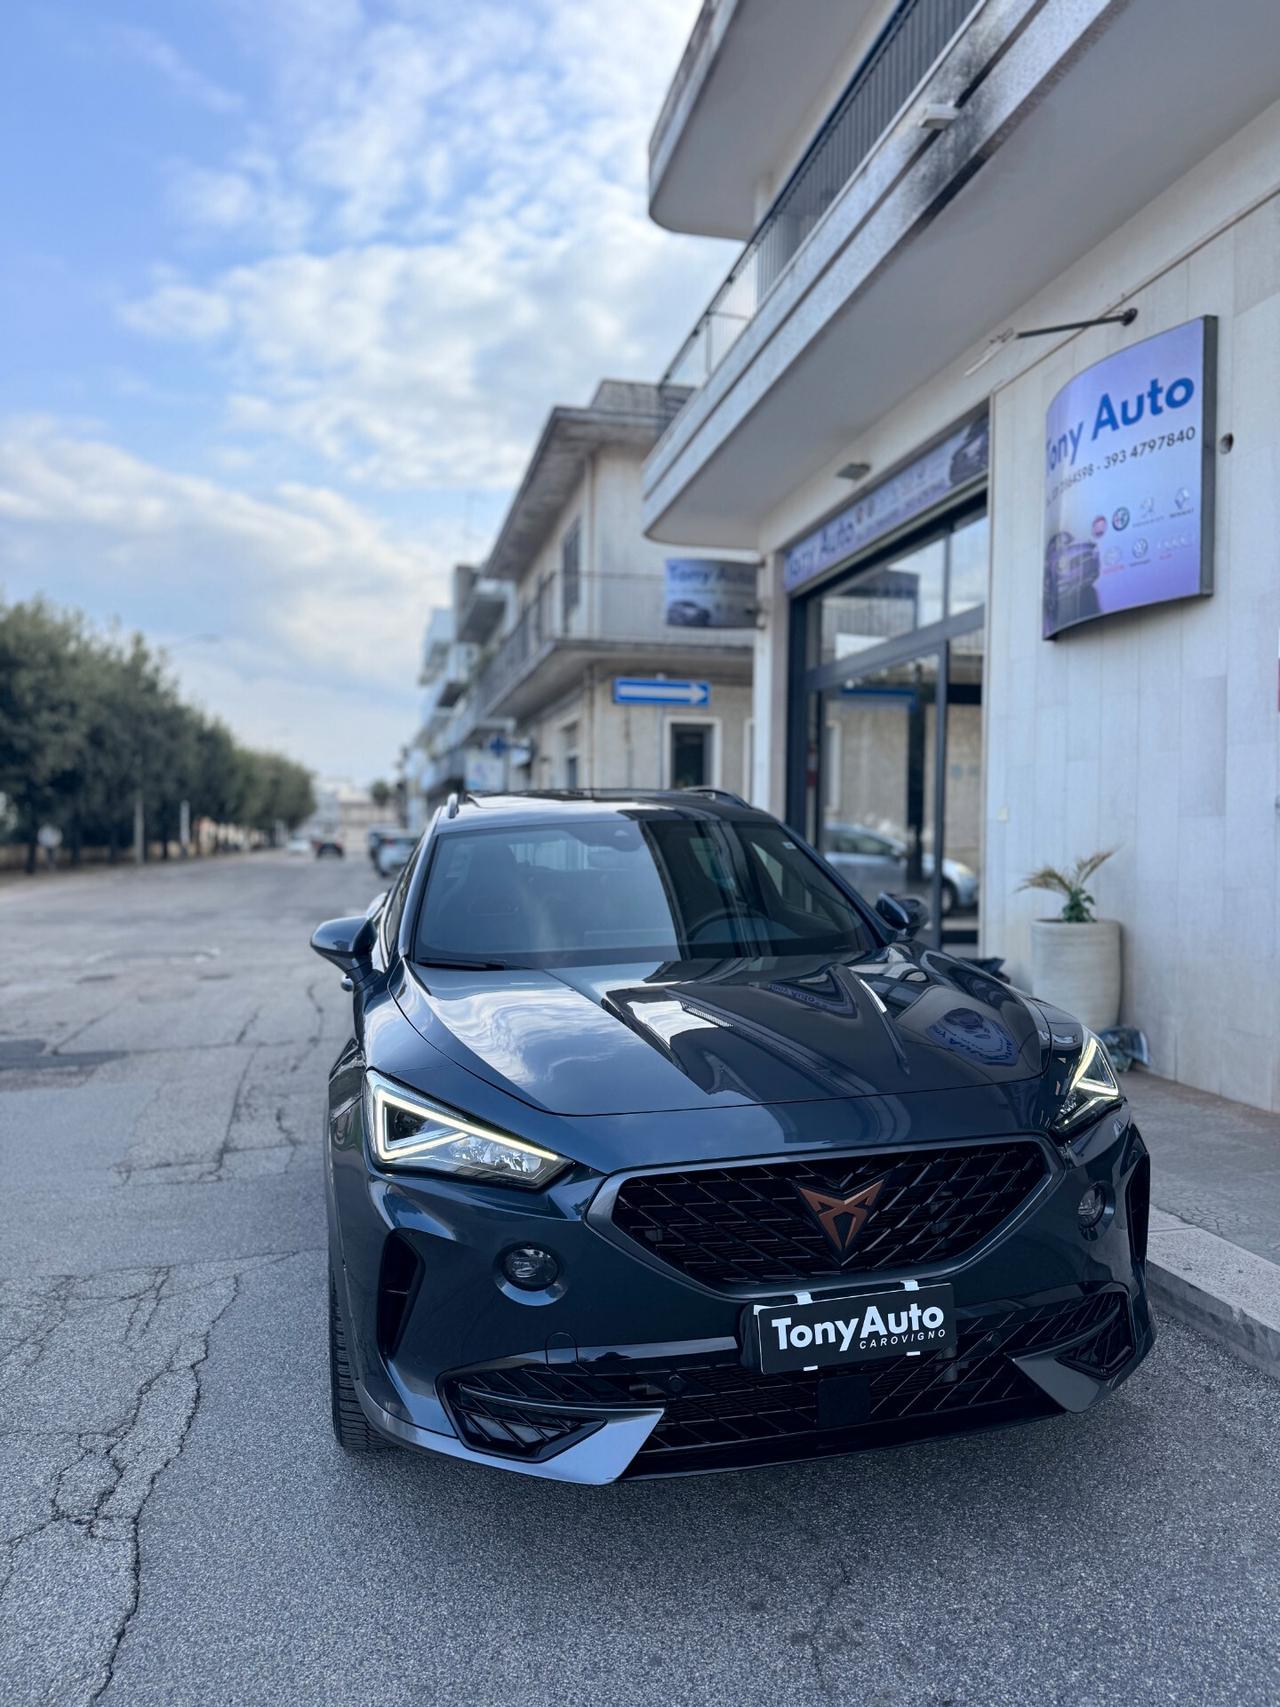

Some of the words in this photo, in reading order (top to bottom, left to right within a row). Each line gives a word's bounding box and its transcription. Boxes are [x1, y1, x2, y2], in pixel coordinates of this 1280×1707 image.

[1091, 377, 1195, 441] Auto
[1104, 450, 1127, 469] 393
[1130, 426, 1196, 459] 4797840
[859, 1329, 946, 1350] CAROVIGNO
